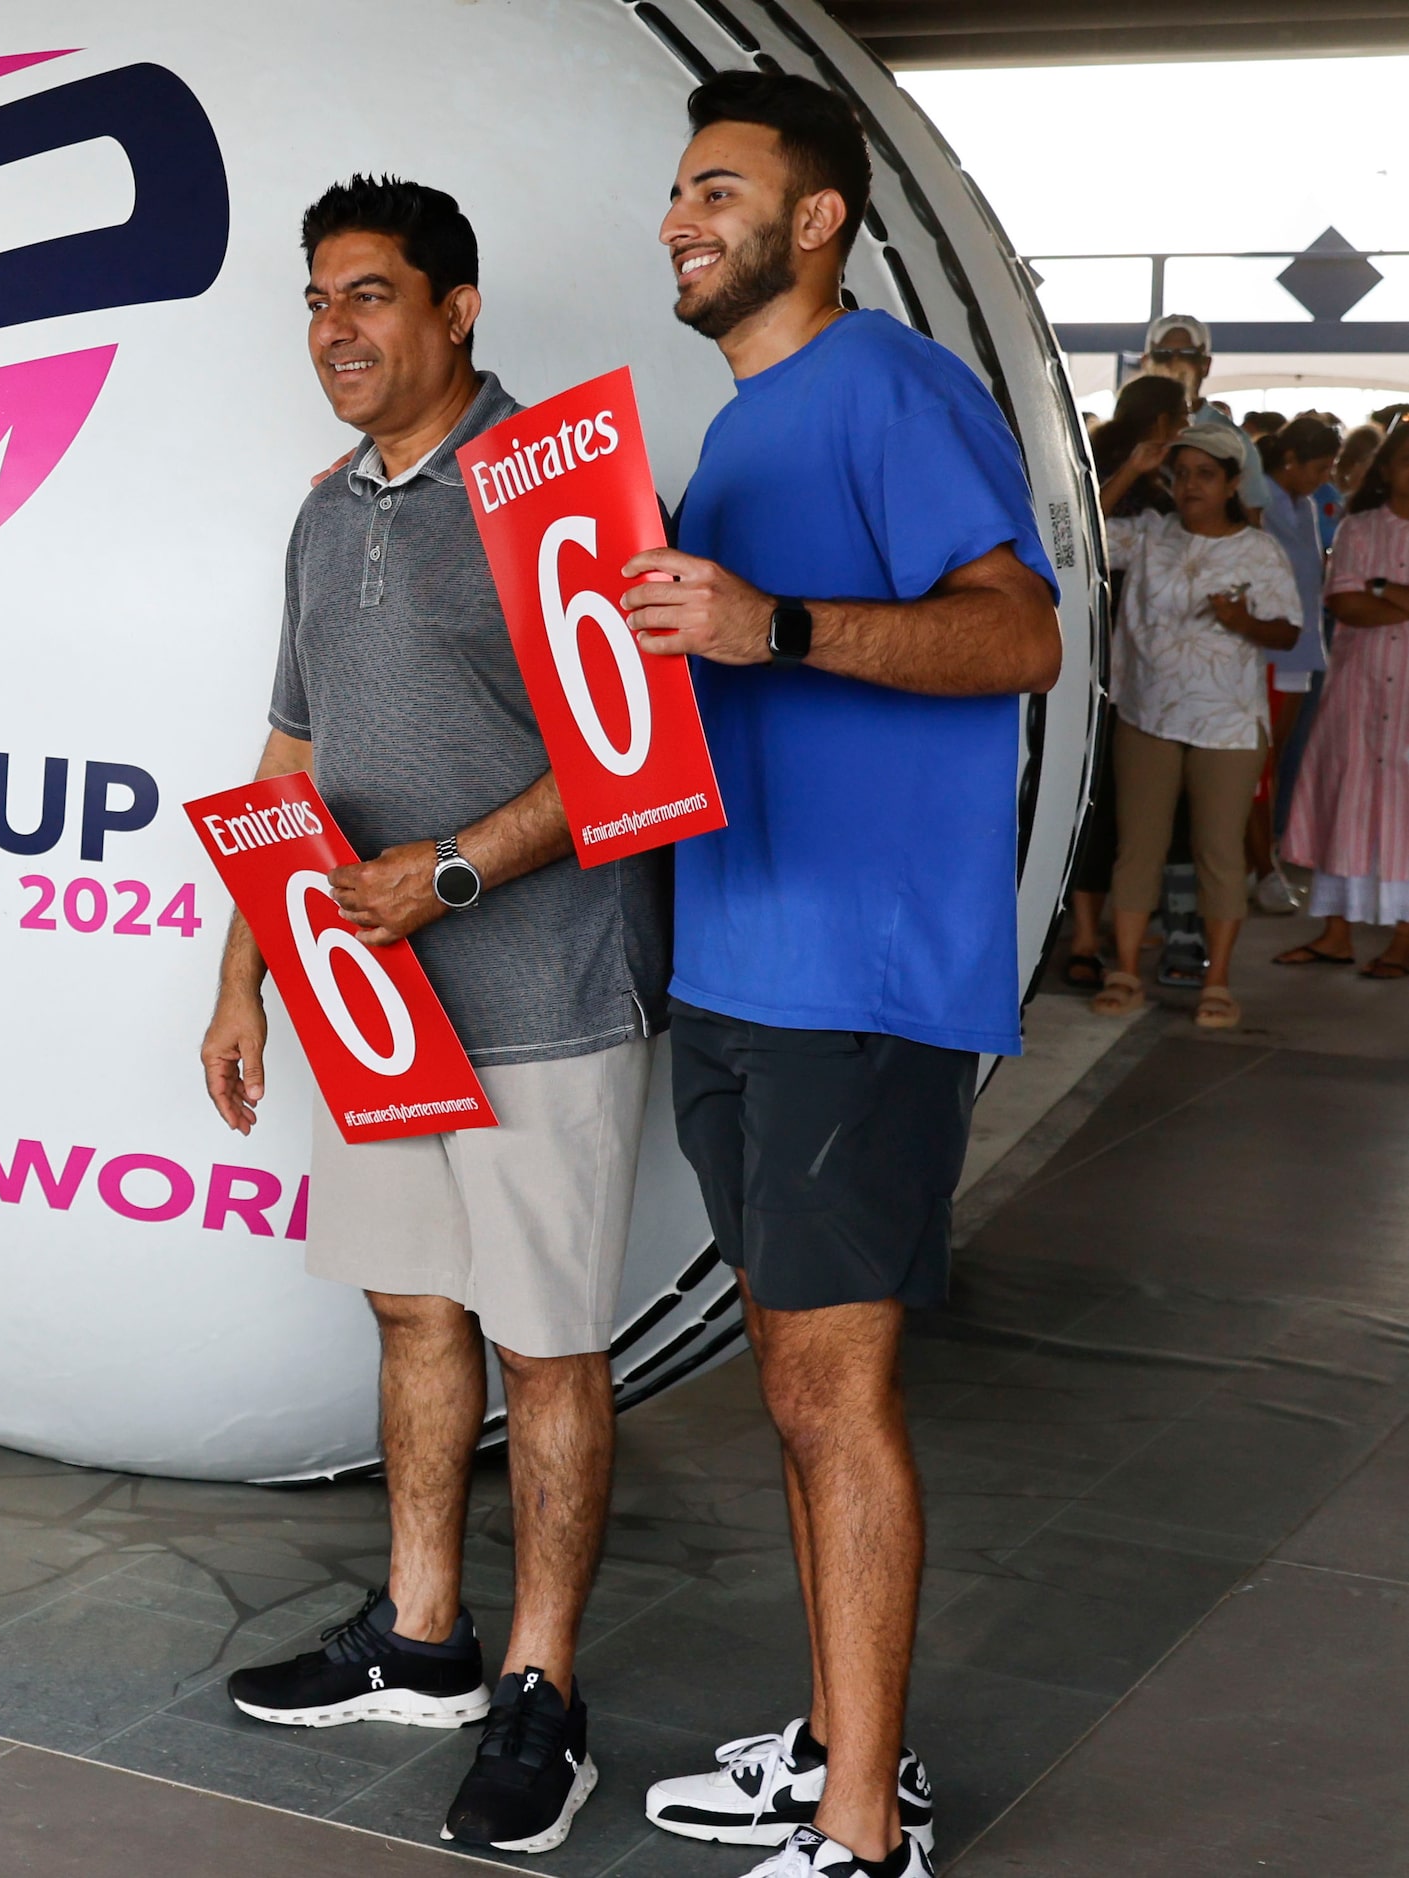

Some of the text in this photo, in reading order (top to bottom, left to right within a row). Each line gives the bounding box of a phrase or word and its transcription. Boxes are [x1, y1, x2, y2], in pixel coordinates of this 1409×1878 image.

[470, 410, 619, 515] Emirates
[538, 515, 652, 777] 6
[202, 798, 323, 856] Emirates
[582, 791, 708, 847] #Emiratesflybettermoments
[19, 874, 203, 938] 2024
[286, 869, 416, 1077] 6
[344, 1097, 479, 1127] #Emiratesflybettermoments
